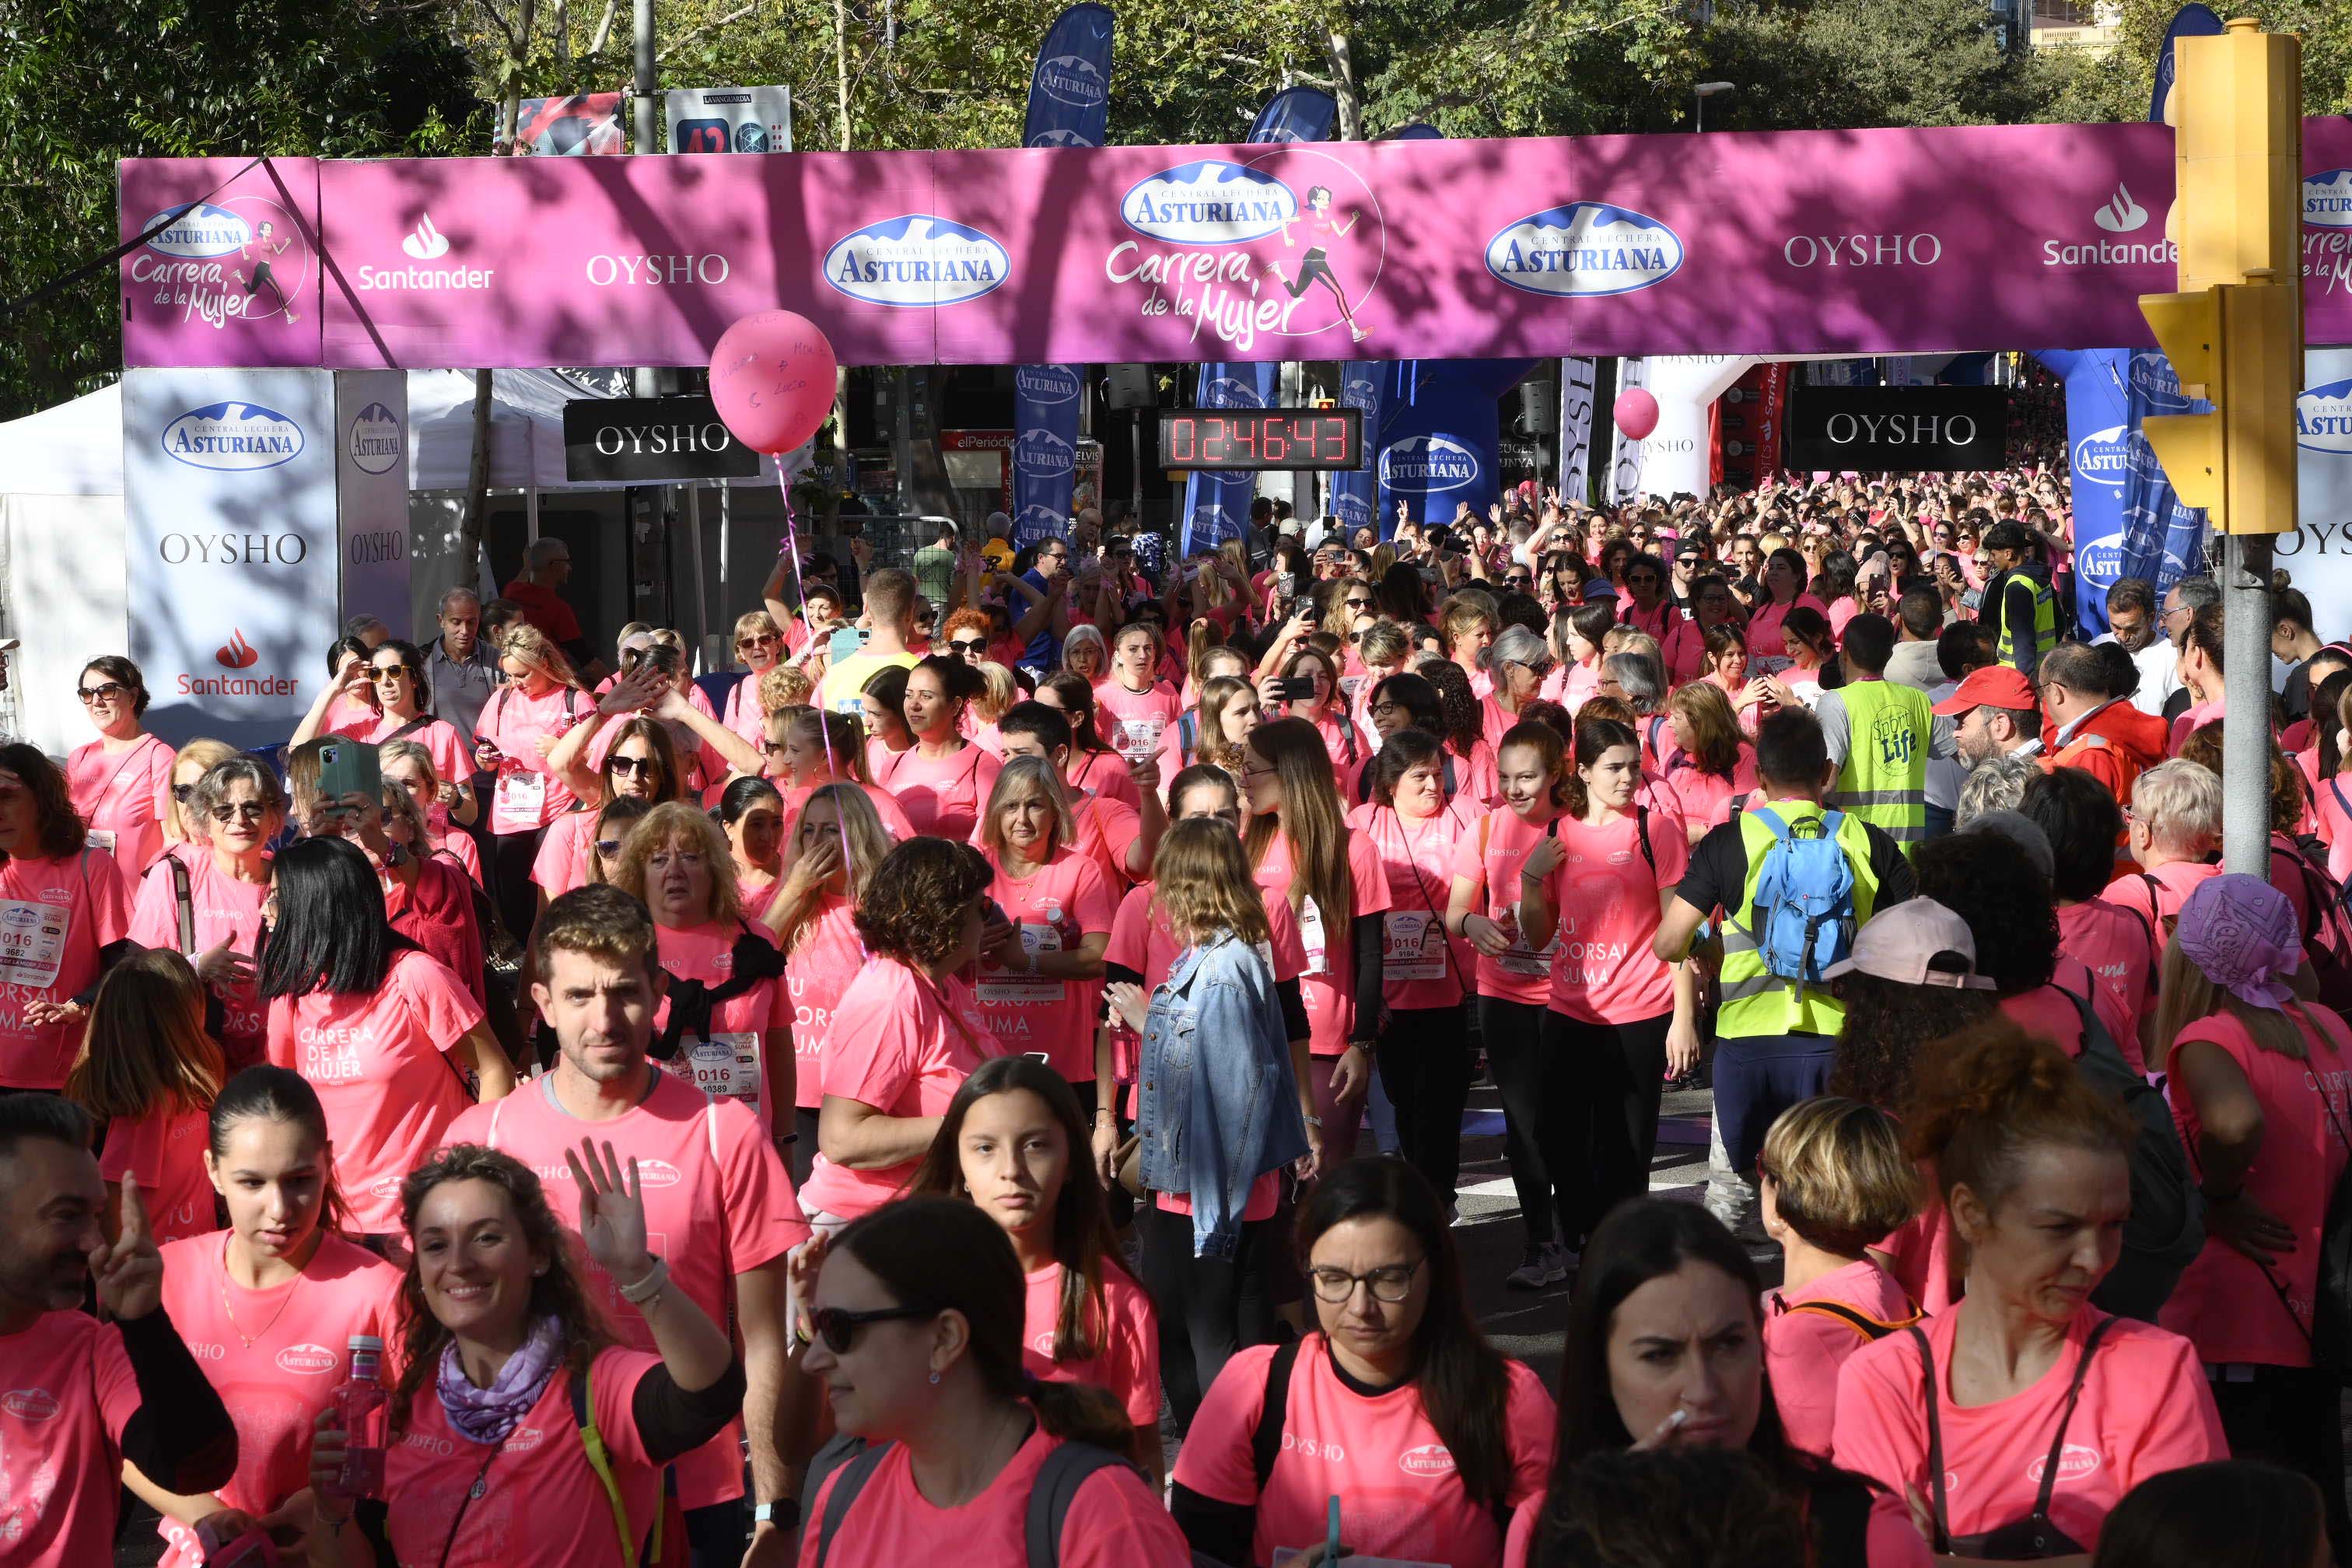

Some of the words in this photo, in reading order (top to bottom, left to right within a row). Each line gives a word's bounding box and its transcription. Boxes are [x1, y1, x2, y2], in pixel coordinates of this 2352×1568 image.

[1134, 192, 1283, 224] ASTURIANA
[1531, 235, 1592, 246] CENTRAL
[1598, 233, 1662, 244] LECHERA
[1783, 233, 1942, 268] OYSHO
[866, 247, 923, 257] CENTRAL
[1105, 240, 1251, 284] Carrera
[1500, 238, 1668, 273] ASTURIANA
[2042, 238, 2179, 266] Santande
[131, 254, 222, 284] Carrera
[586, 254, 729, 286] OYSHO
[838, 249, 996, 283] ASTURIANA
[2302, 265, 2311, 277] e
[2315, 257, 2329, 277] la
[359, 265, 493, 290] Santander
[154, 285, 171, 304] de
[174, 284, 187, 304] la
[184, 280, 257, 329] Mujer
[1141, 285, 1168, 317] de
[1174, 285, 1194, 316] la
[1189, 278, 1306, 352] Mujer
[194, 425, 240, 433] CENTRAL
[244, 424, 290, 433] LECHERA
[1566, 356, 1594, 502] OYSH
[1826, 413, 1976, 446] OYSHO
[2296, 407, 2352, 436] ASTU
[173, 427, 294, 453] ASTURIANA
[353, 429, 399, 457] ASTURIANA
[595, 422, 730, 455] OYSHO
[1172, 418, 1347, 461] 02:46:43
[1645, 439, 1694, 453] YSHO
[1075, 451, 1099, 461] ELVIS
[2081, 448, 2127, 471] ASTU
[1382, 458, 1471, 481] ASTURIANA
[159, 533, 307, 565] OYSHO
[351, 530, 403, 565] OYSHO
[2272, 522, 2352, 556] OYS
[177, 673, 299, 696] Santander
[1873, 710, 1911, 741] Sport
[1881, 729, 1917, 764] Life
[1488, 848, 1521, 857] OYSHO
[1566, 855, 1583, 863] HO
[203, 908, 243, 921] OYSHO
[3, 933, 32, 947] 016
[1394, 938, 1419, 948] 016
[5, 948, 26, 957] 9682
[23, 972, 51, 982] Santander
[1563, 965, 1609, 985] SUMA
[786, 976, 805, 997] U
[983, 1013, 1030, 1034] UMA
[299, 1024, 374, 1046] CARRERA
[792, 1033, 824, 1055] UM
[308, 1045, 330, 1062] DE
[338, 1043, 359, 1061] LA
[694, 1048, 730, 1058] ASTURIANA
[303, 1060, 362, 1080] MUJER
[698, 1068, 730, 1082] 016
[702, 1084, 728, 1094] 10389
[534, 1164, 572, 1180] SHO
[186, 1342, 225, 1361] SHO
[282, 1353, 334, 1367] ASTURIANA
[1282, 1432, 1345, 1463] OYSHO
[1403, 1455, 1457, 1469] ASTURIAN
